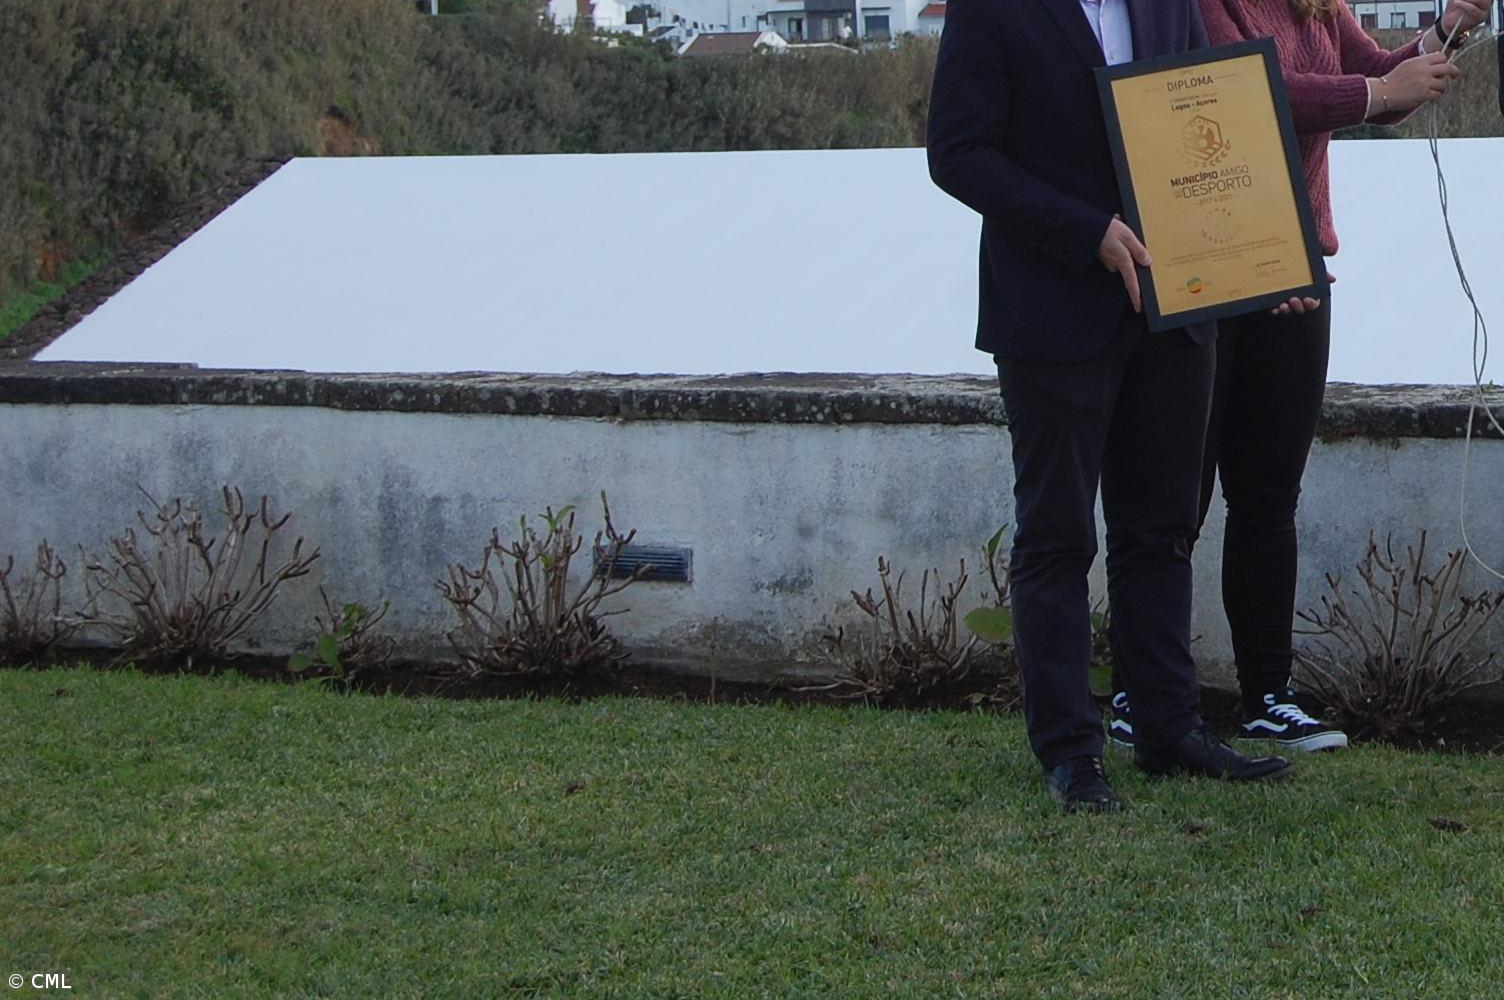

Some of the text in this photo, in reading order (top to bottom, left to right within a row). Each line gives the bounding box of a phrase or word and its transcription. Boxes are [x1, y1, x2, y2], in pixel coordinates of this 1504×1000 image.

[1166, 75, 1214, 92] DIPLOMA
[1170, 170, 1218, 187] MUNICÍPIO
[1182, 174, 1252, 199] DESPORTO
